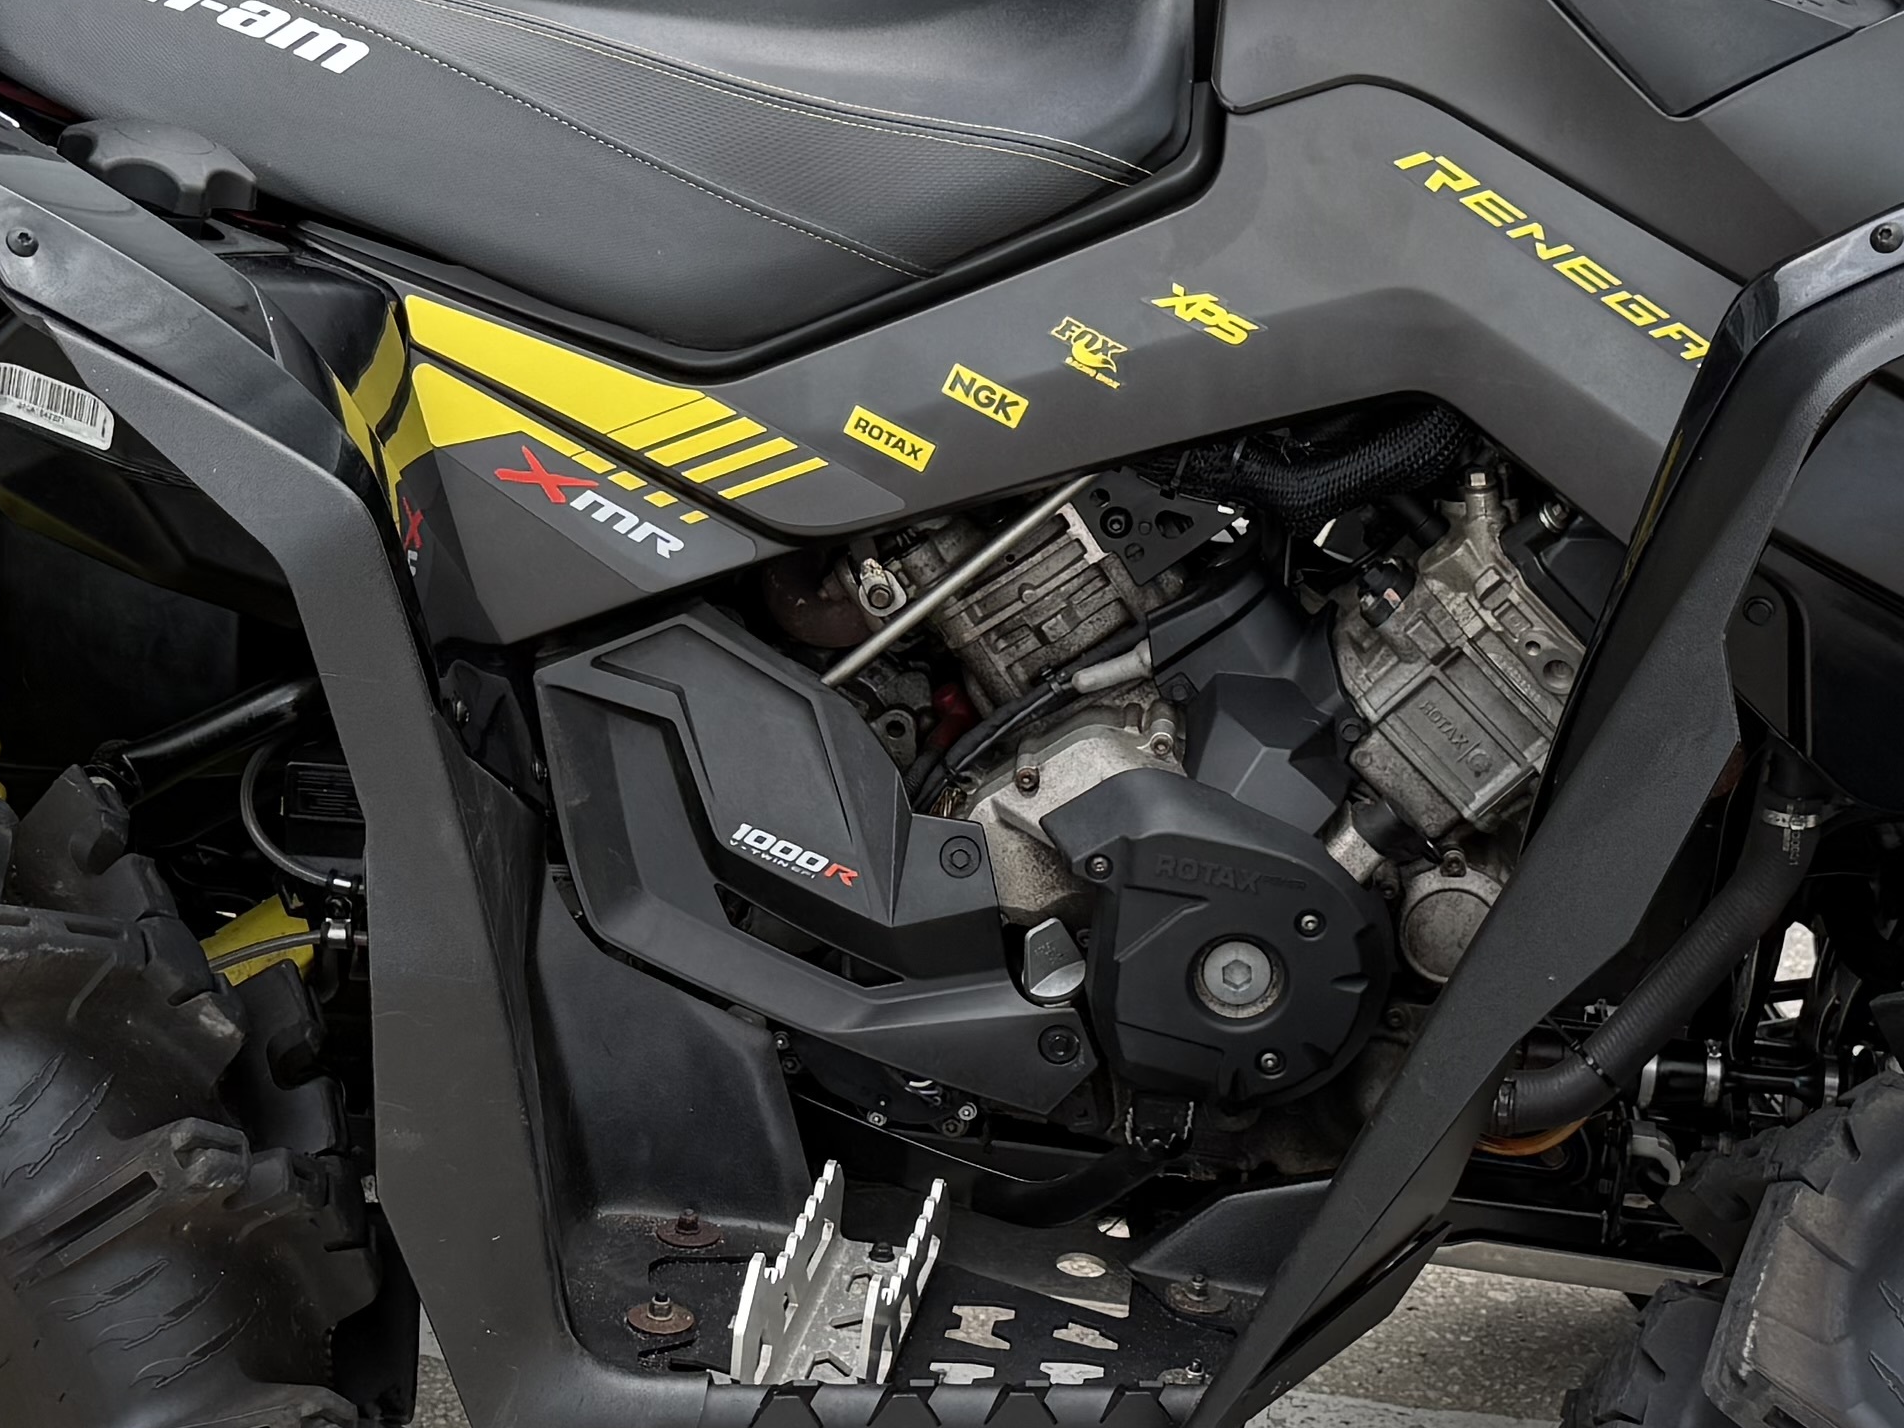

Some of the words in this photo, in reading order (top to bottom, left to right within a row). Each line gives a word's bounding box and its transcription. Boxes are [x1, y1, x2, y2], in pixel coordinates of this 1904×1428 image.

[1050, 316, 1129, 359] FOX
[1151, 282, 1260, 346] XPS
[948, 371, 1020, 422] NGK
[852, 417, 924, 463] ROTAX
[731, 822, 860, 888] 1000R
[1155, 854, 1260, 894] ROTAX
